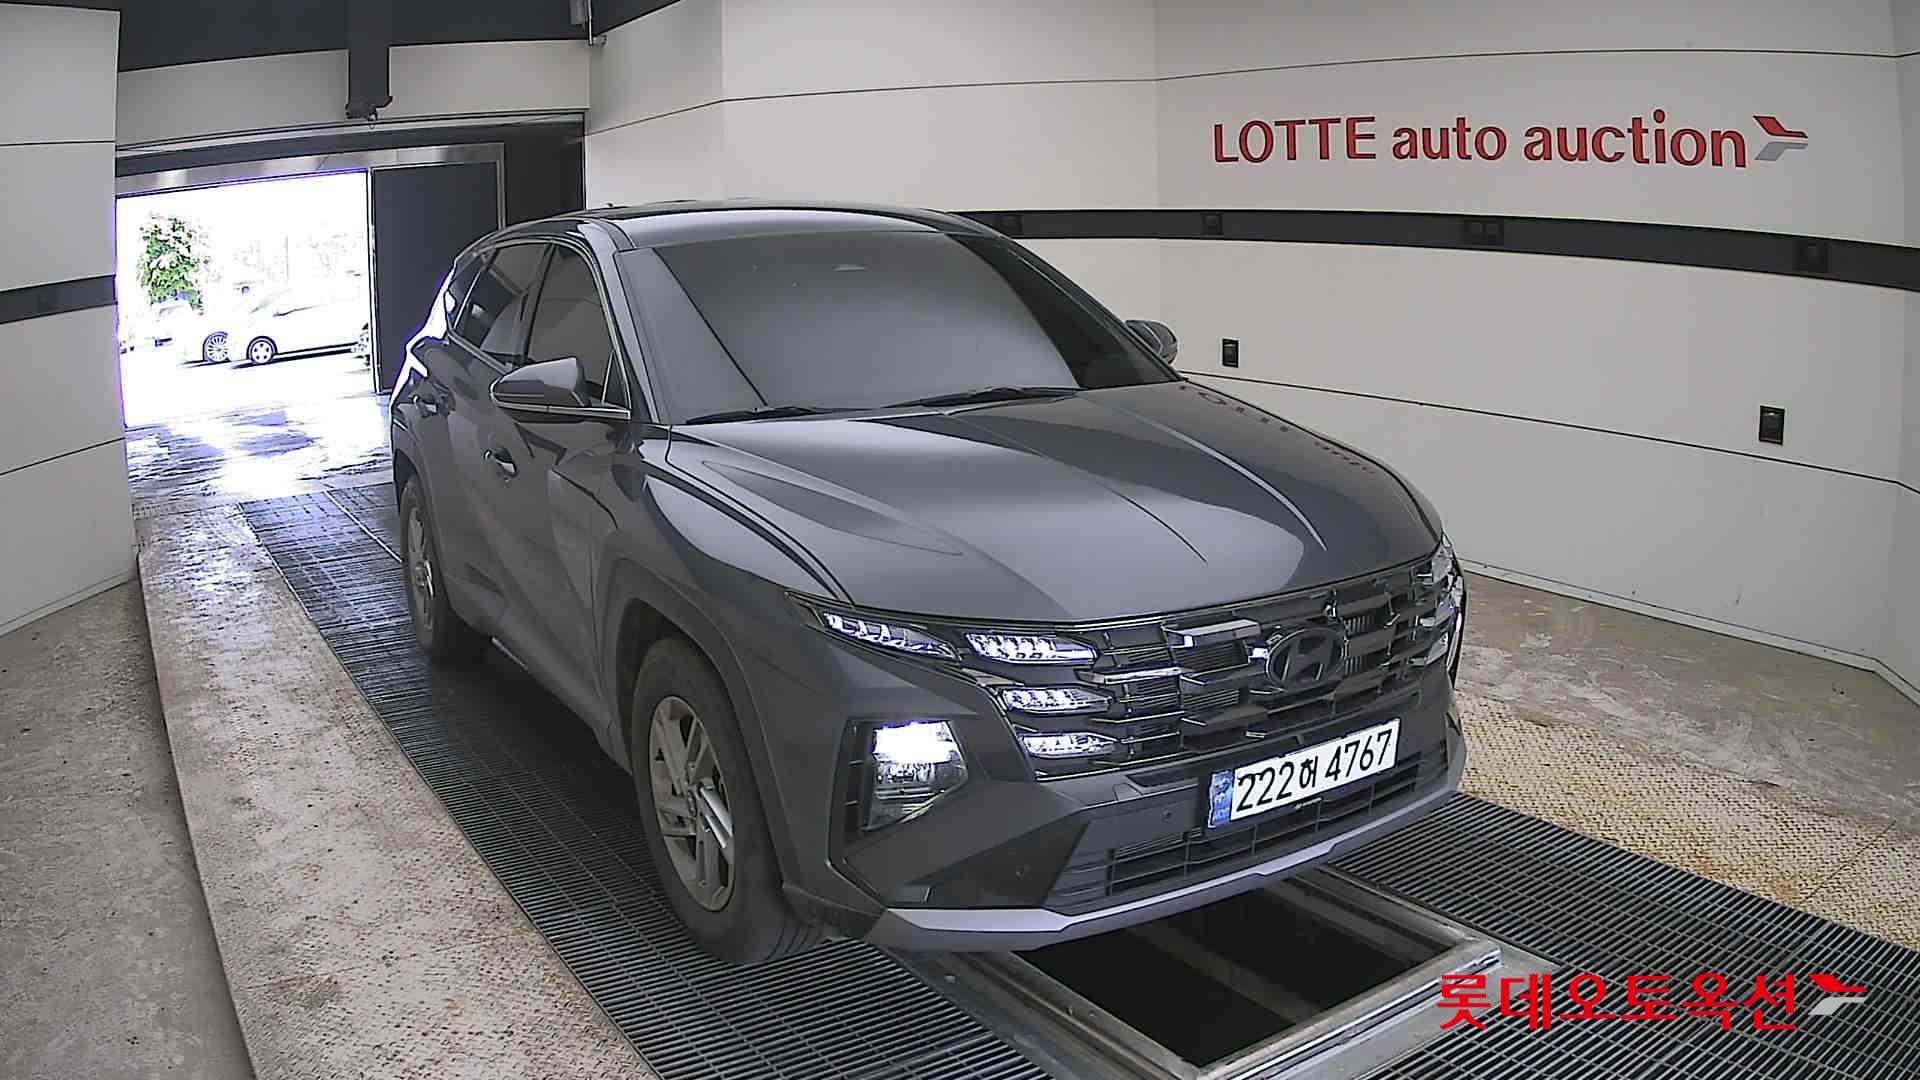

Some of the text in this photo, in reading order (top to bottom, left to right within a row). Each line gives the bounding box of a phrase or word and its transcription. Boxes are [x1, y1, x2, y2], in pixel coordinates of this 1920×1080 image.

[1213, 108, 1747, 169] LOTTE auto auction
[1236, 729, 1393, 812] 222허 4767
